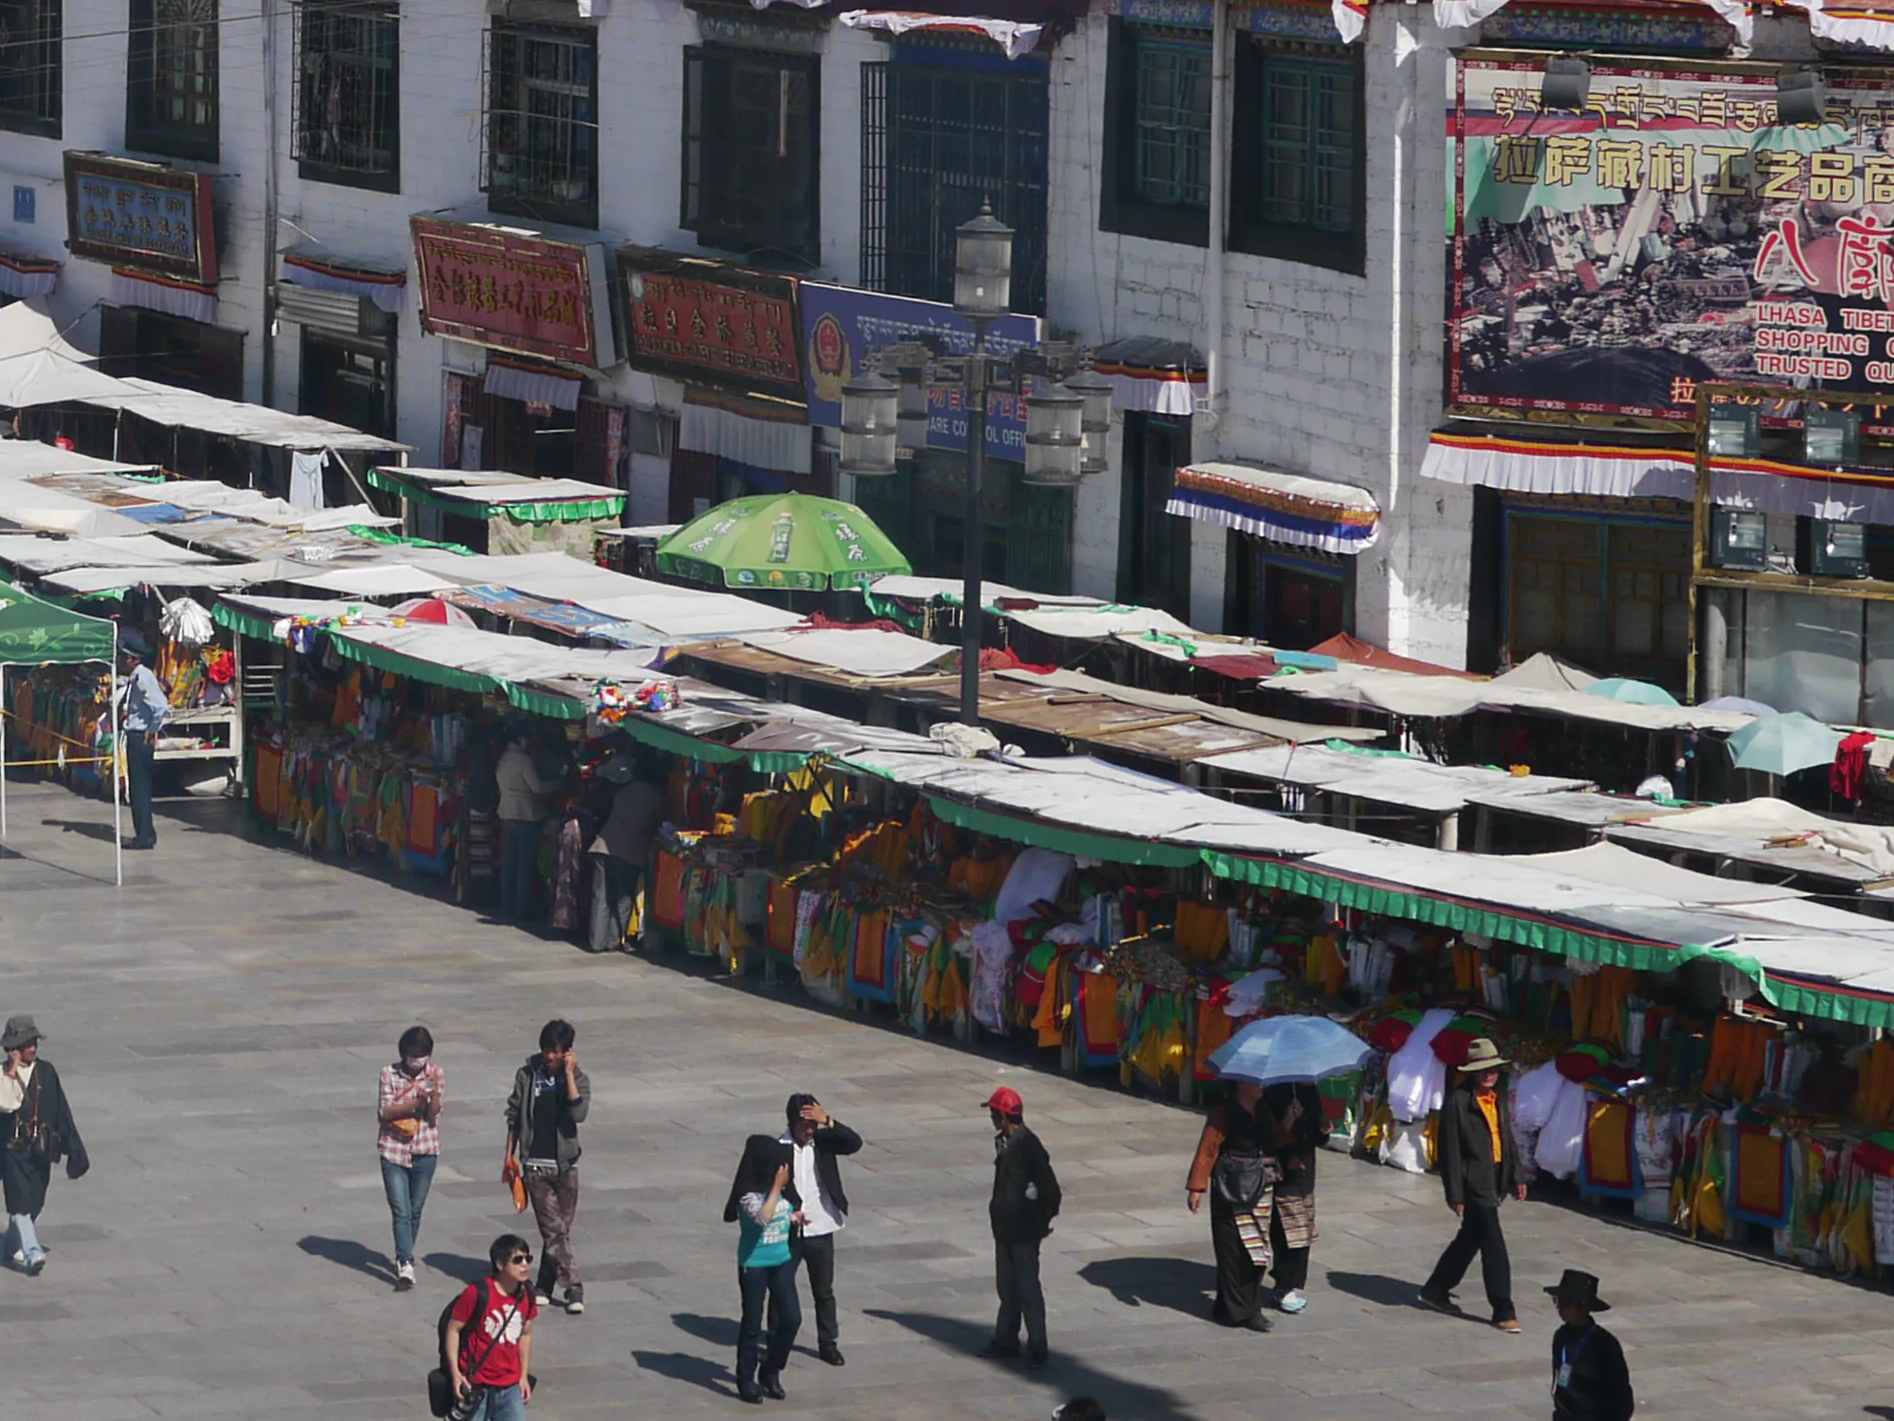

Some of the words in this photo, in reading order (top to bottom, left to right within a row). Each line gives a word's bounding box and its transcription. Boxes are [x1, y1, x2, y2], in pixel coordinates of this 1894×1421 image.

[1757, 307, 1826, 326] LHASA
[1756, 330, 1869, 354] SHOPPING
[1756, 355, 1851, 378] TRUSTED
